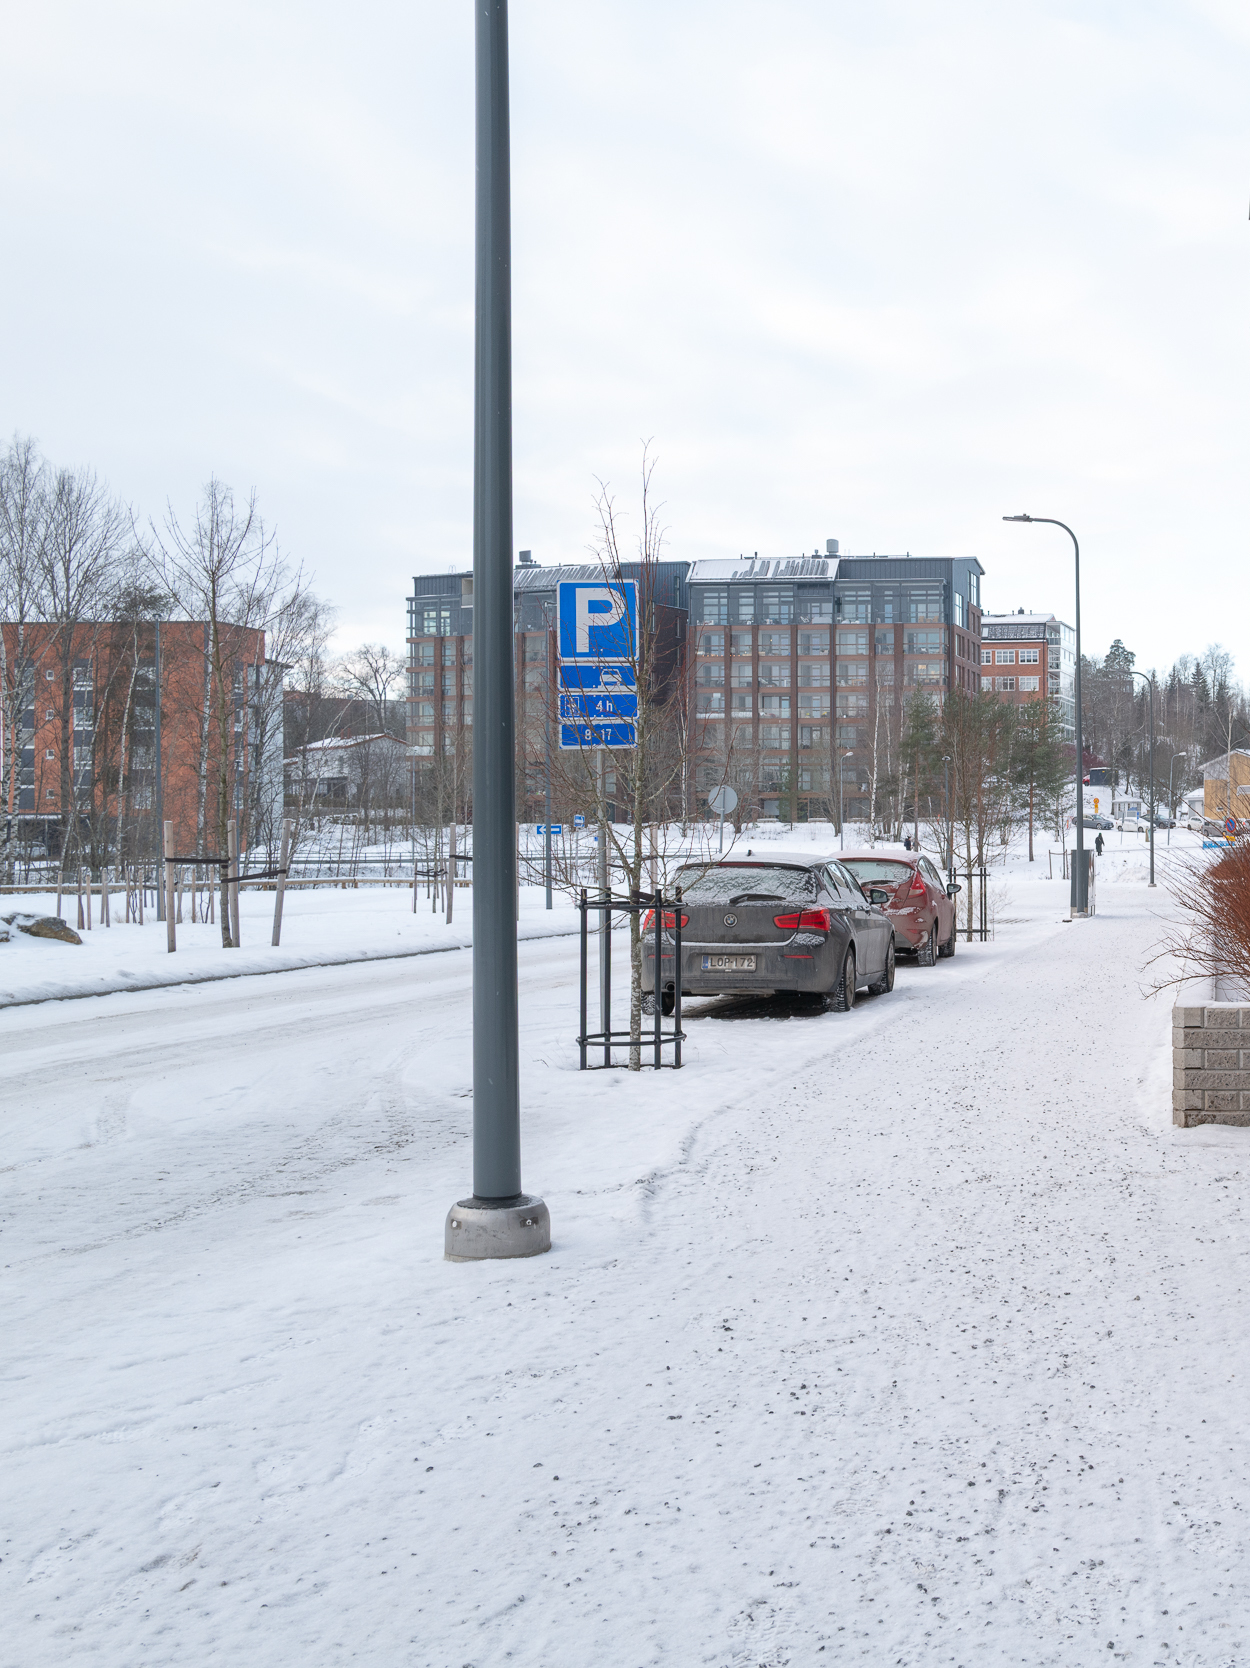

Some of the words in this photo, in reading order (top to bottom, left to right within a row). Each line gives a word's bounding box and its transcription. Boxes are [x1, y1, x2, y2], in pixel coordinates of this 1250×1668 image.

[576, 588, 626, 653] P
[596, 700, 603, 712] 4
[606, 700, 613, 712] h
[710, 957, 754, 968] LOP-172
